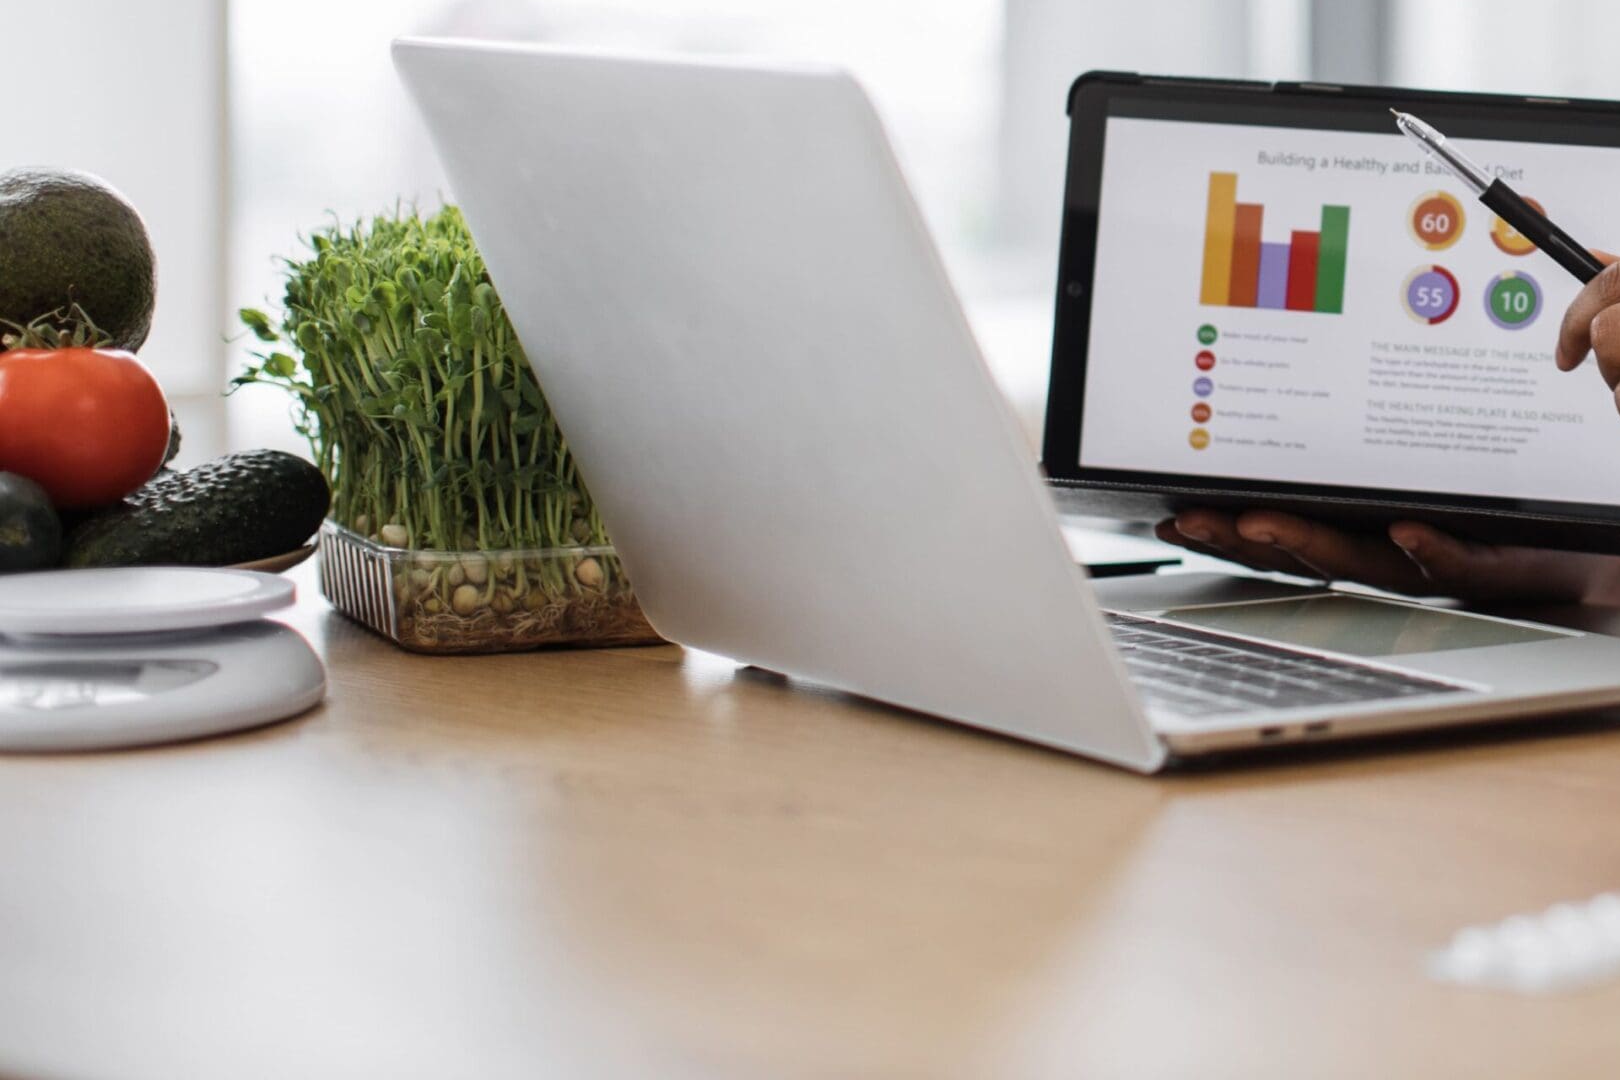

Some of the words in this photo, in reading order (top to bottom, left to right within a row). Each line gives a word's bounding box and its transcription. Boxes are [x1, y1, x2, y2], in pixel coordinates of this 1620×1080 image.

[1257, 151, 1316, 170] Building
[1319, 158, 1330, 169] a
[1333, 157, 1387, 175] Healthy
[1392, 161, 1420, 175] and
[1495, 165, 1525, 181] Diet
[1421, 213, 1449, 233] 60
[1415, 287, 1443, 308] 55
[1501, 290, 1529, 313] 10
[1370, 342, 1389, 351] THE
[1392, 343, 1420, 353] MAIN
[1423, 345, 1469, 357] MESSAGE
[1473, 348, 1487, 358] OF
[1490, 350, 1509, 359] THE
[1512, 351, 1550, 362] HEALTH
[1366, 398, 1385, 409] THE
[1388, 400, 1433, 412] HEALTHY
[1436, 403, 1473, 415] EATING
[1476, 406, 1506, 417] PLATE
[1510, 408, 1537, 419] ALSO
[1541, 410, 1584, 422] ADVISES
